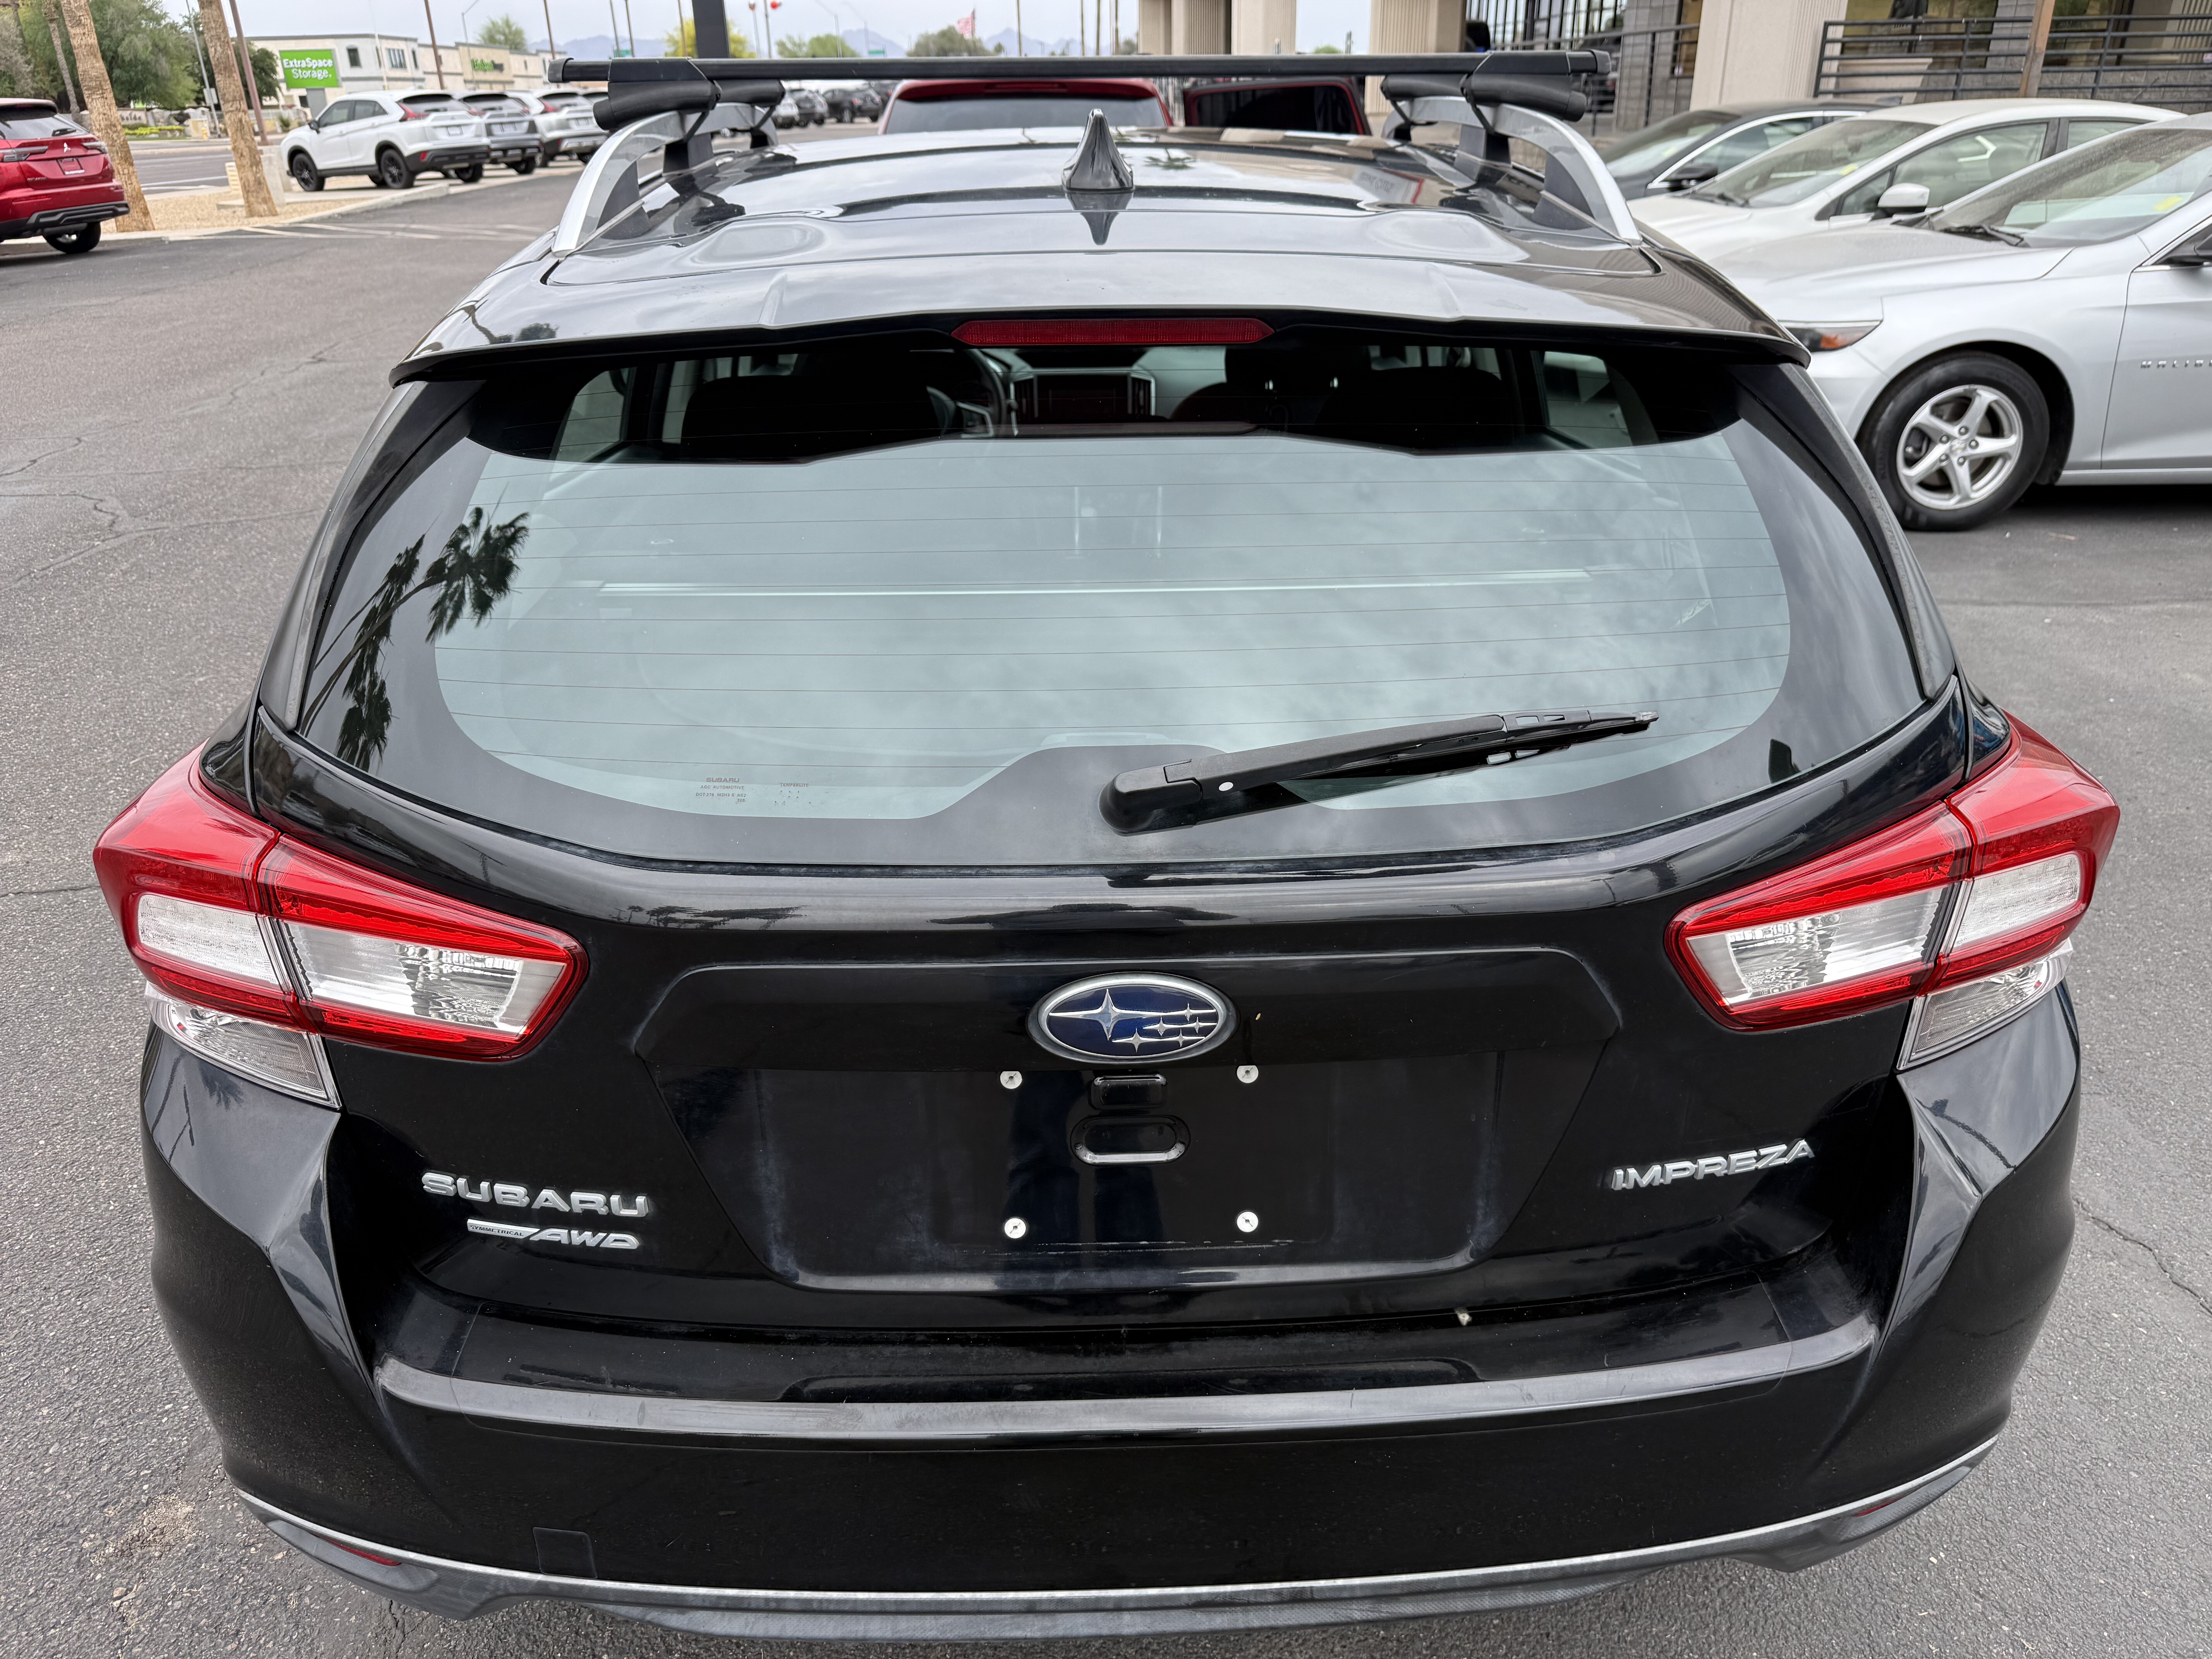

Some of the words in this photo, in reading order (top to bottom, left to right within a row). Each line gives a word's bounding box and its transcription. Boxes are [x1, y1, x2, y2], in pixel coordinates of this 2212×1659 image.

[2141, 360, 2212, 369] MALIB
[1611, 1139, 1815, 1190] IMPREZA
[422, 1171, 649, 1218] SUBARU
[469, 1225, 524, 1237] SYMMETRICAL
[529, 1228, 640, 1249] AWD
